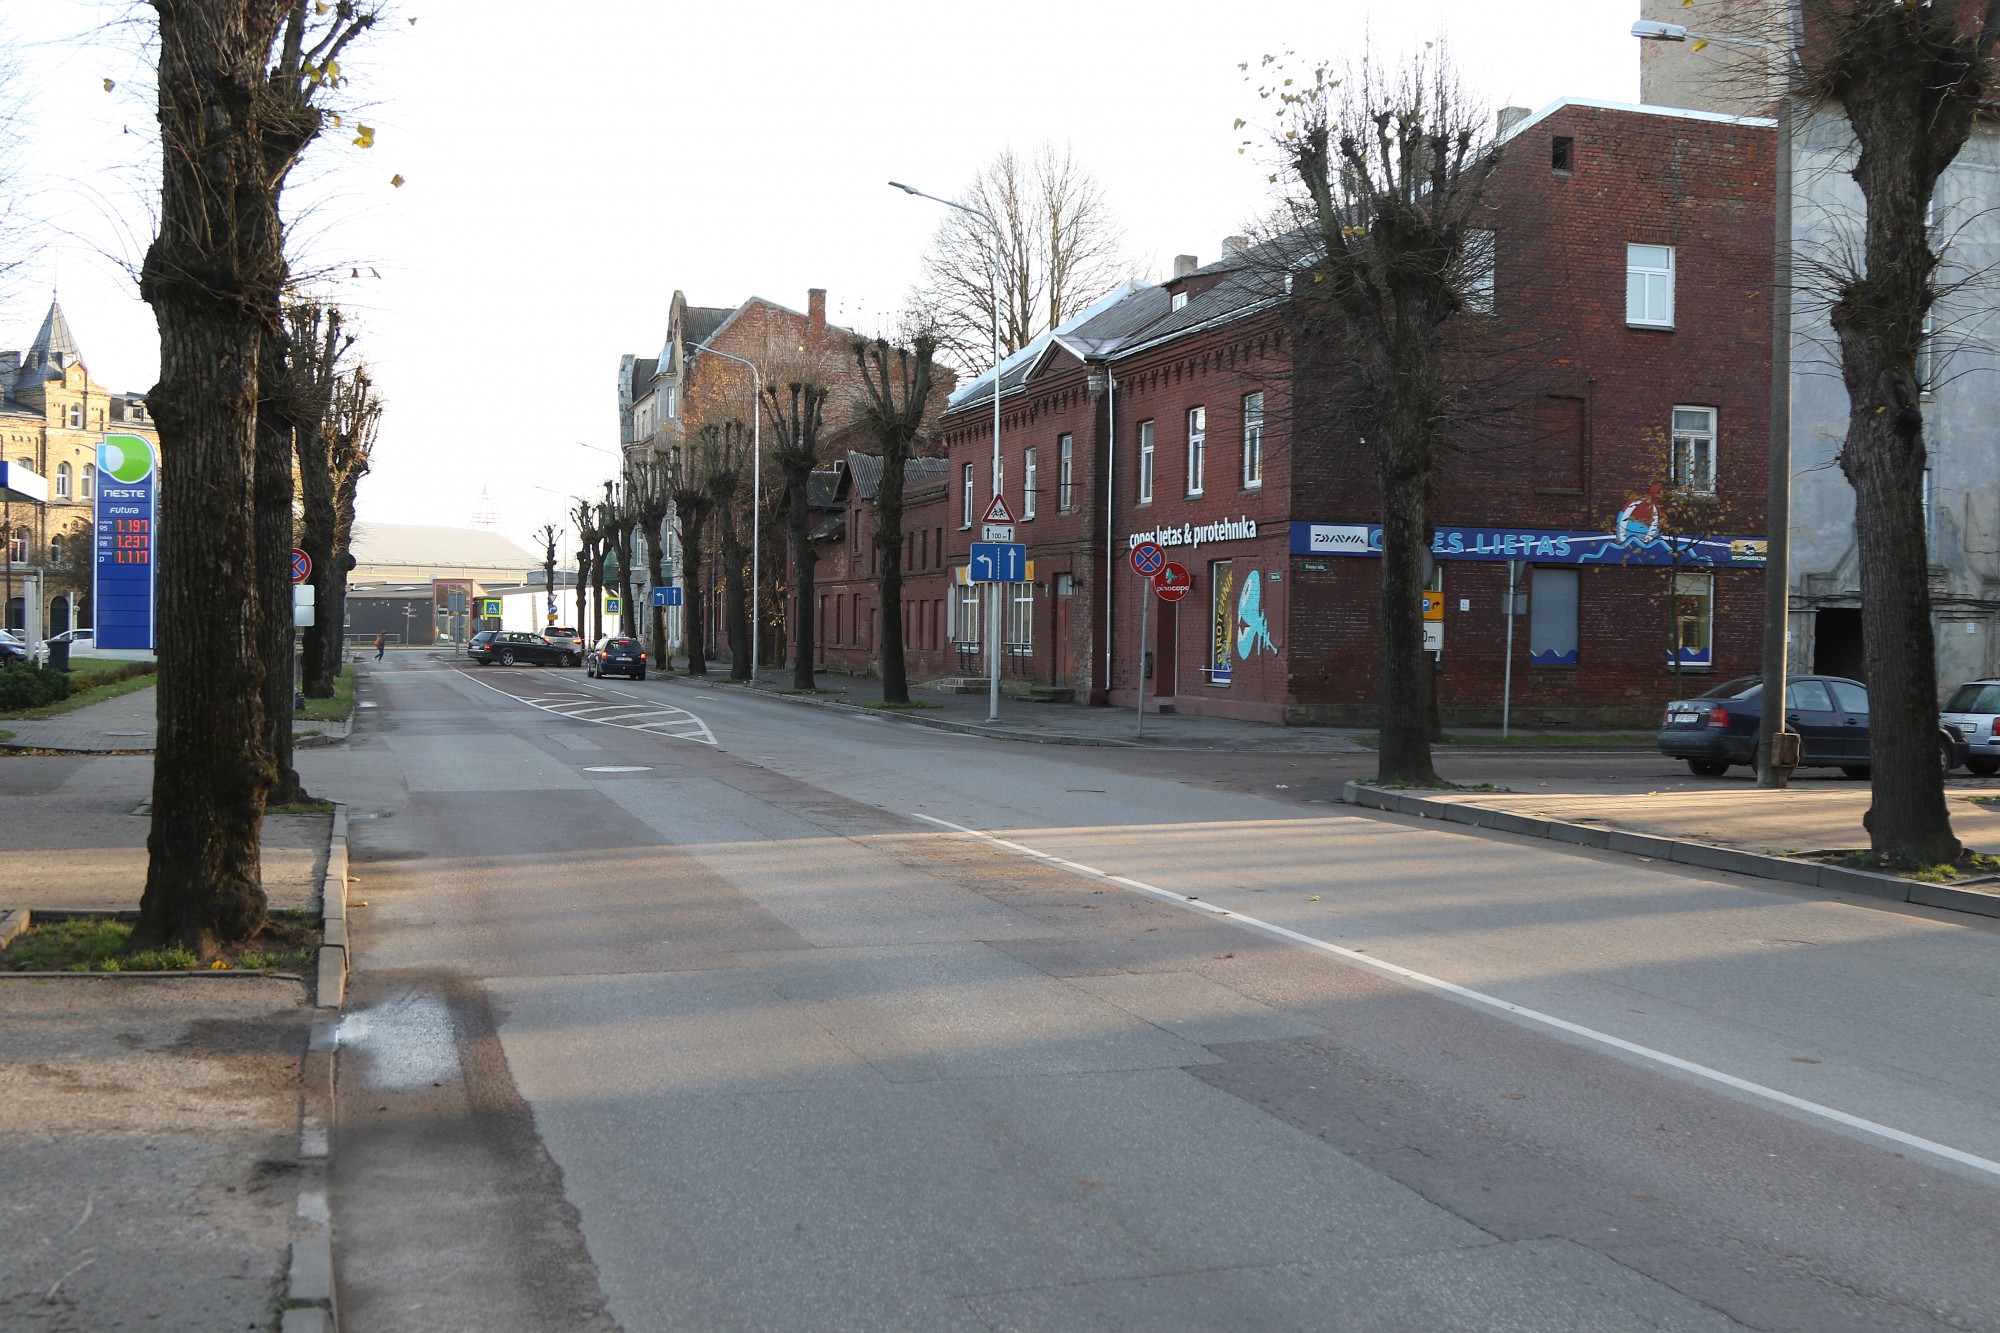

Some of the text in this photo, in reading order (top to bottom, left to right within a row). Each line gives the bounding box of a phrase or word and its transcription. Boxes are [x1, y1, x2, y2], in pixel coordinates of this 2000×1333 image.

[104, 489, 146, 498] NESTE
[110, 506, 139, 514] Futura
[117, 519, 149, 533] 1.197
[1184, 522, 1192, 545] &
[1194, 514, 1257, 549] pirotehnika
[117, 535, 149, 548] 1.237
[1314, 533, 1365, 544] DAIWA
[1369, 529, 1571, 557] CES LIETAS
[117, 550, 149, 564] 1.117
